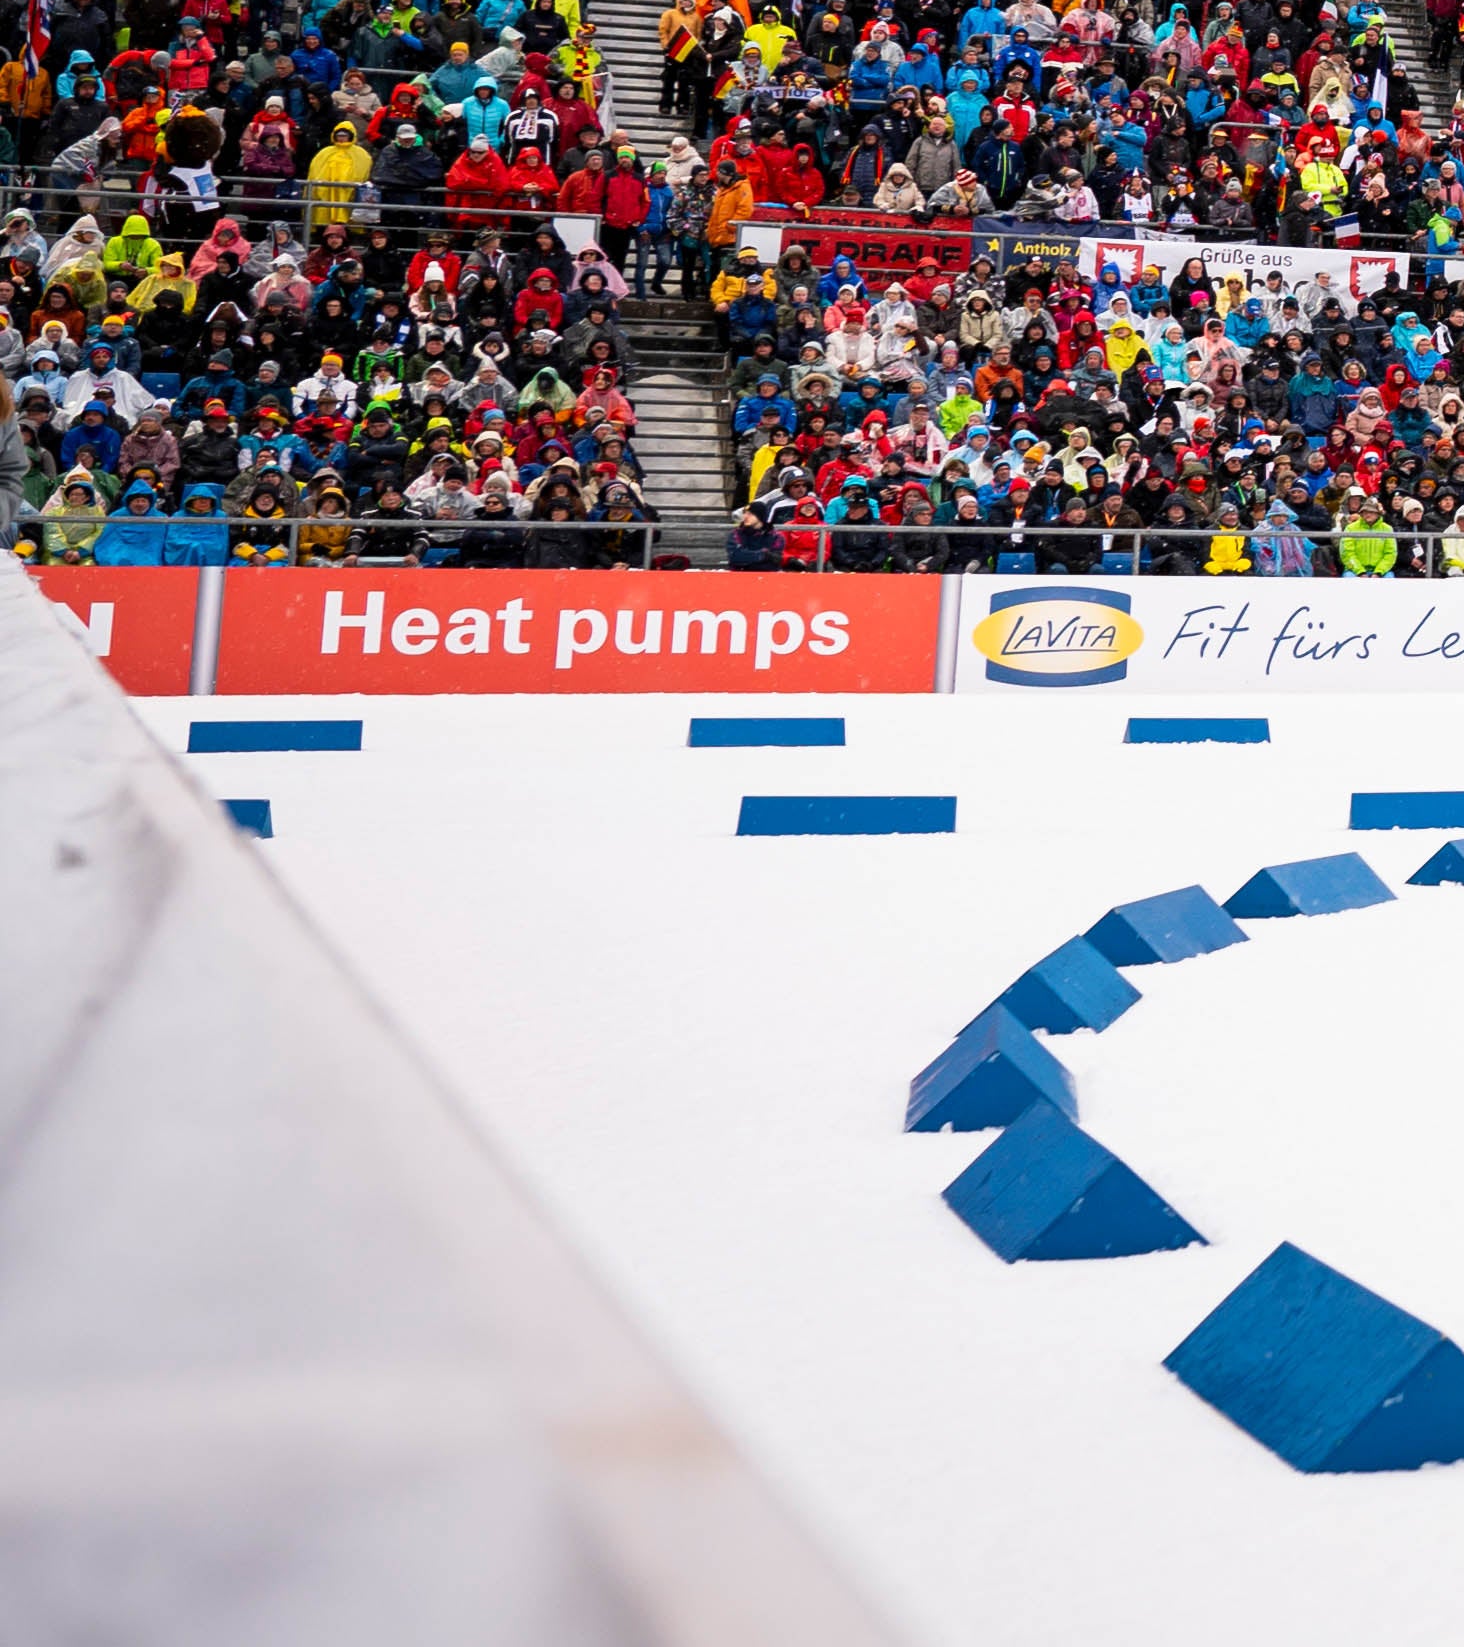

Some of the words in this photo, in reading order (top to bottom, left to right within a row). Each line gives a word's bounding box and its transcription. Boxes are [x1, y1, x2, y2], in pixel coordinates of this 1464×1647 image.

[1013, 241, 1072, 256] Antholz
[1200, 248, 1255, 265] Grüße
[1261, 253, 1293, 267] aus
[321, 590, 533, 655] Heat
[555, 608, 850, 670] pumps
[1163, 602, 1250, 658] Fit
[1266, 606, 1377, 675] fürs
